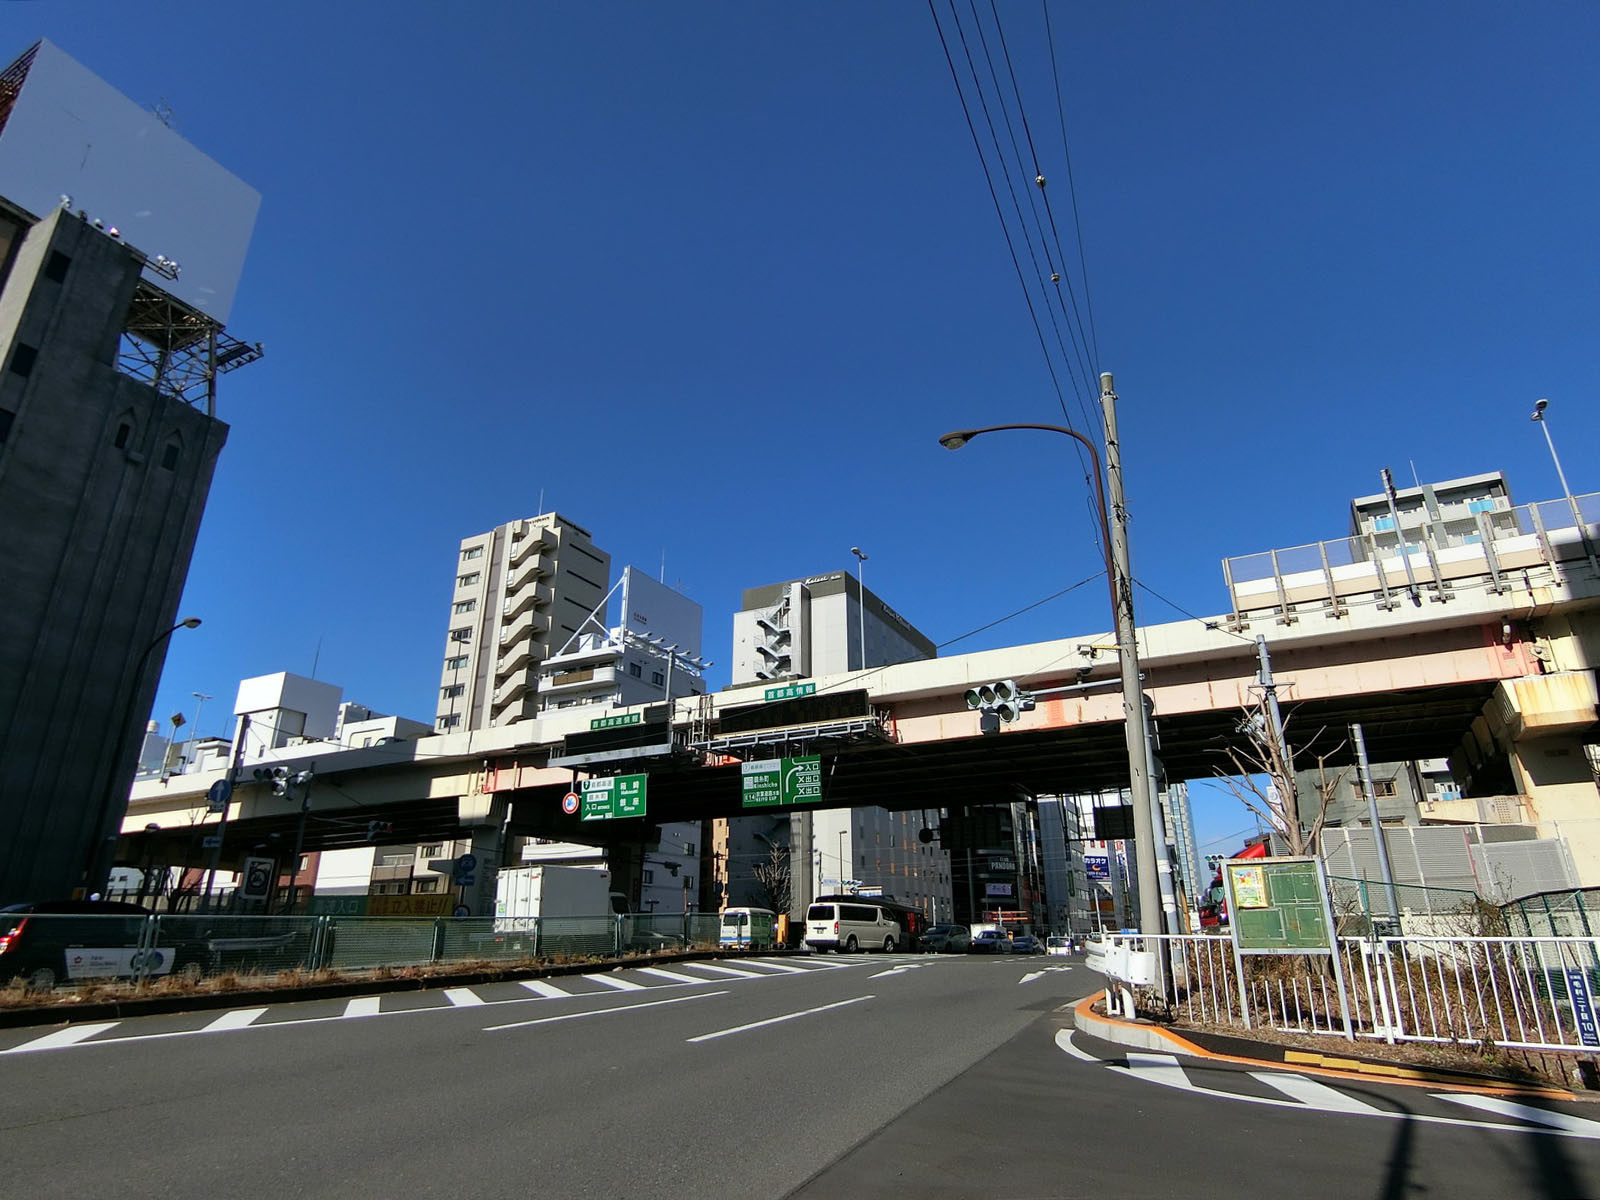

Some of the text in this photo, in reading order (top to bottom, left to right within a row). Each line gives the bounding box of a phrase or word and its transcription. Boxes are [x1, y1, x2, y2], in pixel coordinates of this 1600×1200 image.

[991, 861, 1016, 870] PANDORA
[1084, 857, 1107, 865] カラオケ
[1581, 1022, 1594, 1032] 10
